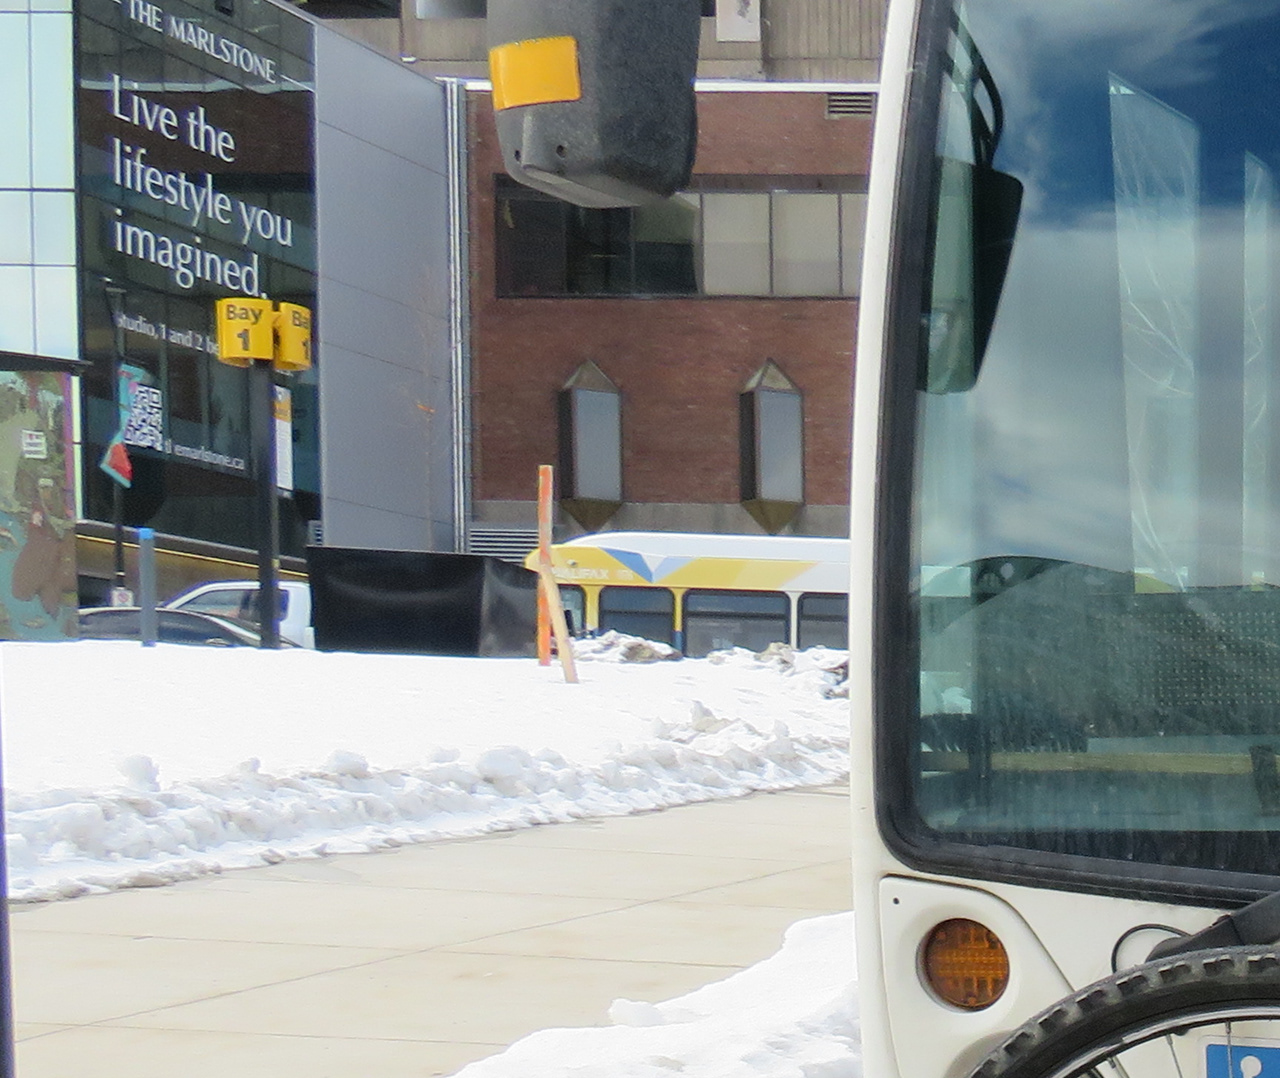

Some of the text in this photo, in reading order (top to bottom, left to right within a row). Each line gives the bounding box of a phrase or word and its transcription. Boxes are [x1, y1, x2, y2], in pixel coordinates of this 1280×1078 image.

[130, 0, 276, 84] THE MARLSTONE
[113, 73, 235, 163] Live the
[113, 137, 292, 247] lifestyle you
[113, 208, 267, 300] imagined.
[171, 330, 192, 348] and
[226, 304, 262, 325] Bay
[237, 328, 249, 351] 1
